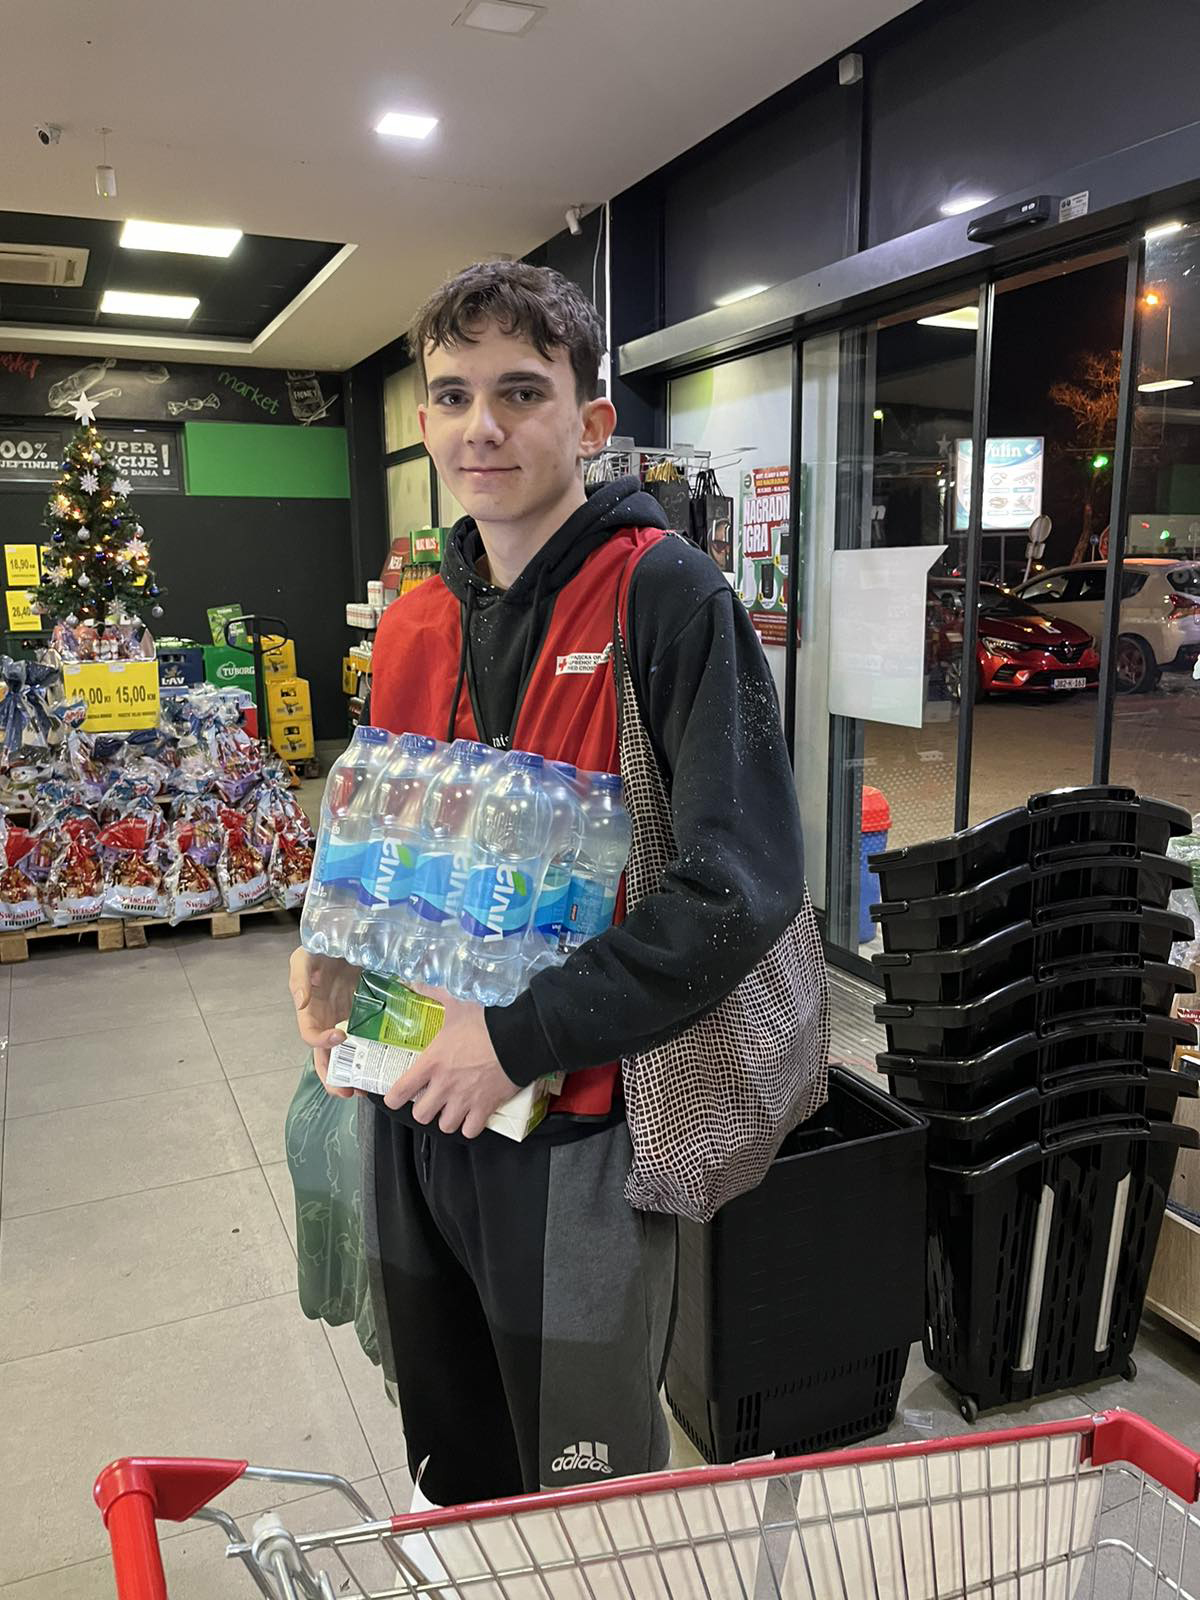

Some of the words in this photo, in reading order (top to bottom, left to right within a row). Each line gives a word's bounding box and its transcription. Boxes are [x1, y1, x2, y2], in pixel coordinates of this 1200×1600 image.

[218, 371, 279, 415] market
[104, 441, 157, 454] UPER
[114, 455, 158, 468] CIJE
[743, 494, 790, 525] NAGRADN
[743, 522, 768, 553] IGRA
[161, 677, 184, 686] LAV
[222, 667, 255, 677] TUBORG
[116, 685, 146, 706] 15,00
[551, 1453, 614, 1474] adidas
